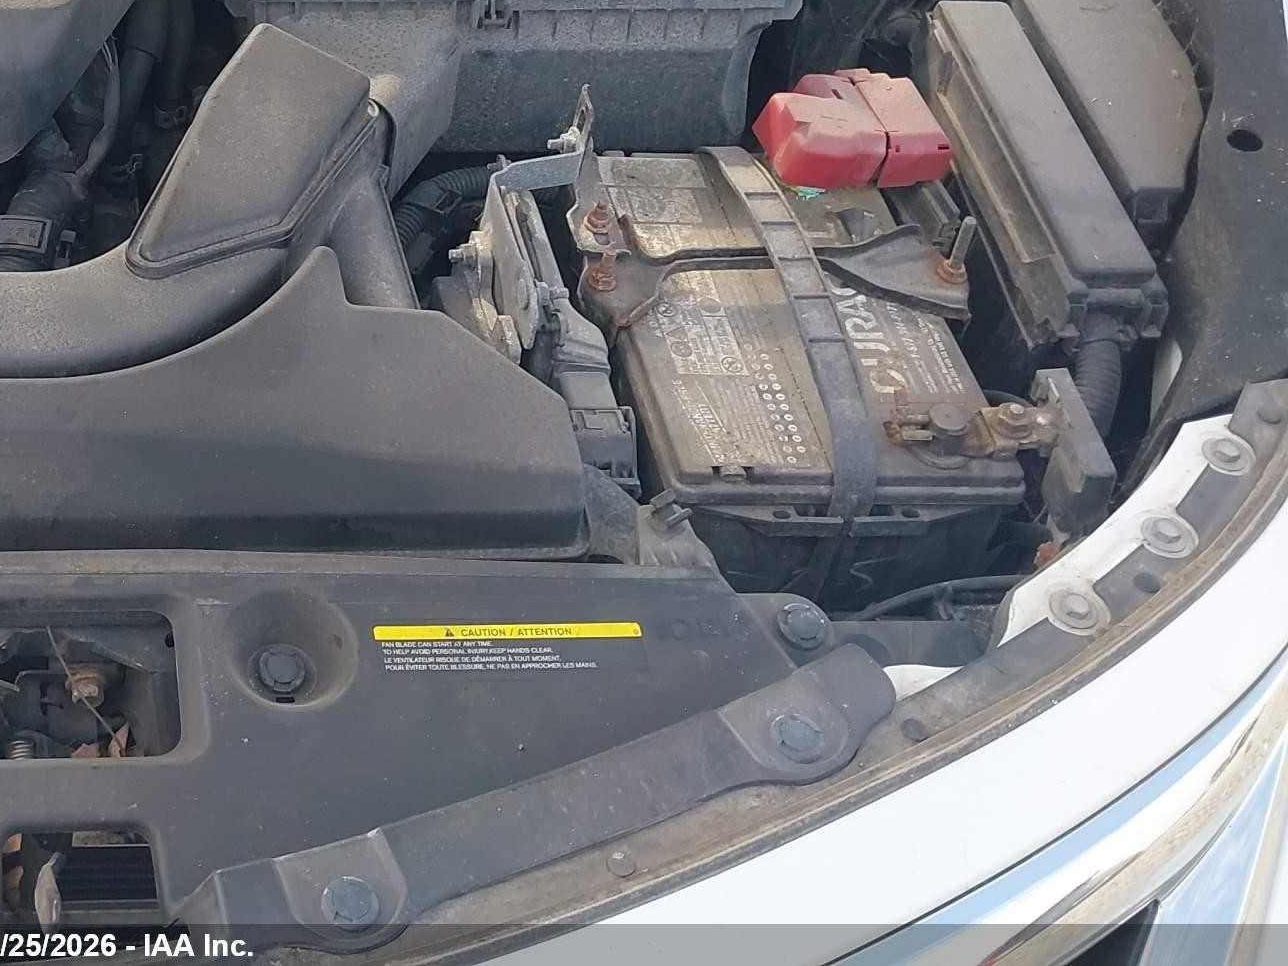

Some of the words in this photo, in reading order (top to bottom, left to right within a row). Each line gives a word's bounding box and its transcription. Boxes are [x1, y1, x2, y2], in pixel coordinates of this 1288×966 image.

[460, 628, 506, 636] CAUTION
[509, 628, 513, 636] /
[517, 627, 572, 636] ATTENTION
